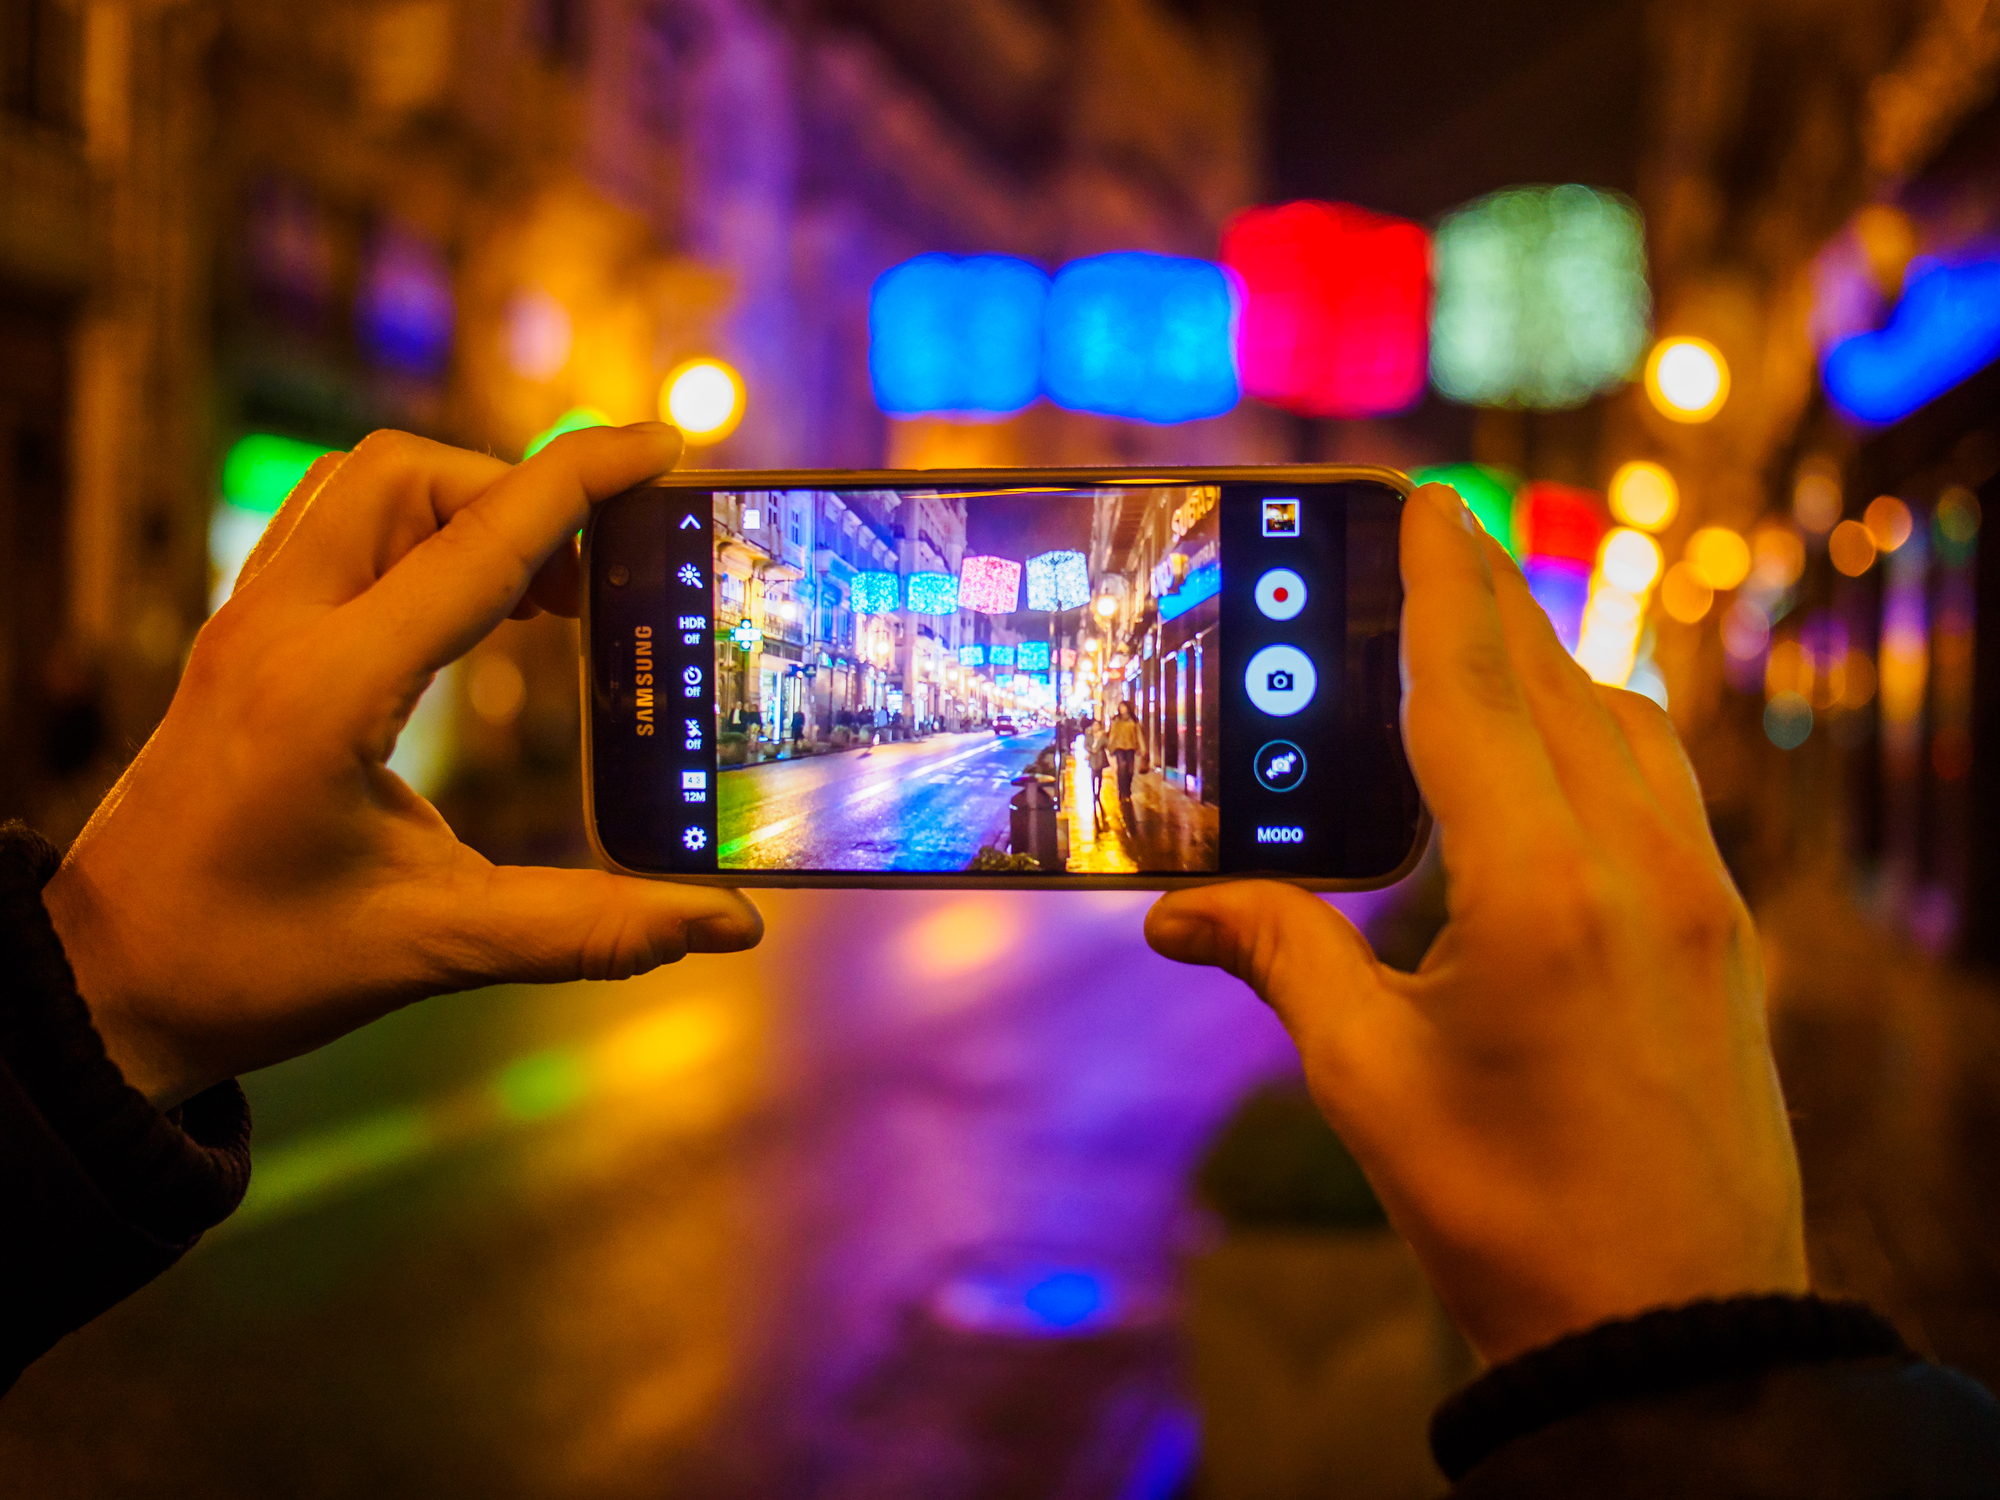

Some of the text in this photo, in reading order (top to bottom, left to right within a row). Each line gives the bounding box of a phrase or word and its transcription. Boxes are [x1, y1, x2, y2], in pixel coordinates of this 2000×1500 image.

[679, 615, 707, 629] HDR
[683, 633, 701, 645] Off
[635, 626, 654, 736] SAMSUNG
[684, 686, 702, 698] Off
[685, 739, 702, 750] Off
[683, 791, 706, 803] 12M
[1257, 827, 1304, 843] MODO
